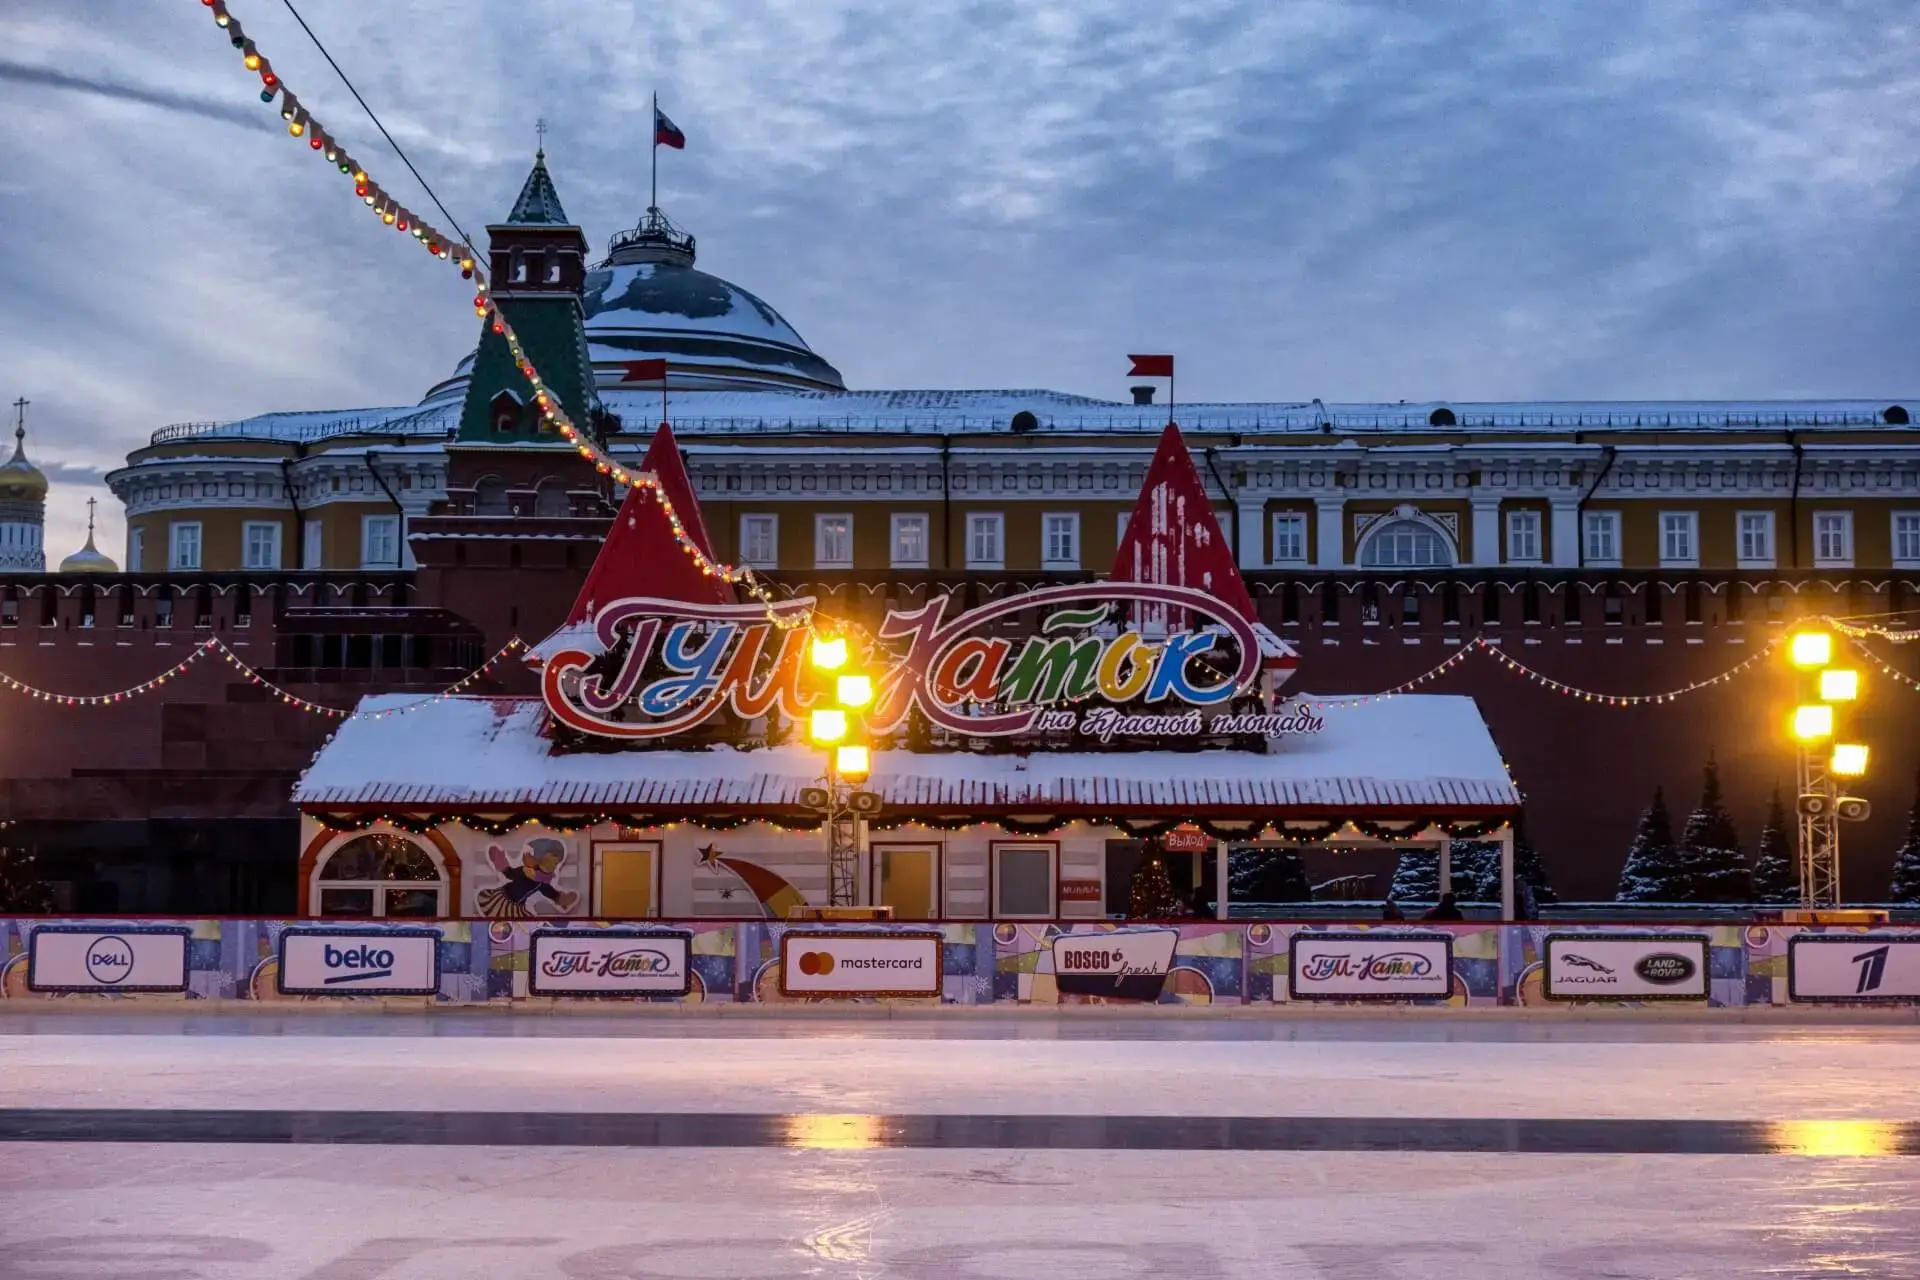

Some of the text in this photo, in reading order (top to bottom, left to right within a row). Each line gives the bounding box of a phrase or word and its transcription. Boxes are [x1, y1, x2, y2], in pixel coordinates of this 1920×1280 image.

[1039, 703, 1325, 743] на Красной площади
[92, 953, 128, 966] DELL
[324, 944, 394, 968] beko
[841, 957, 922, 969] mastercard
[1064, 950, 1110, 969] BOSCO
[1647, 959, 1676, 968] LAND
[1114, 960, 1158, 988] fresh
[1650, 968, 1685, 977] ROVER
